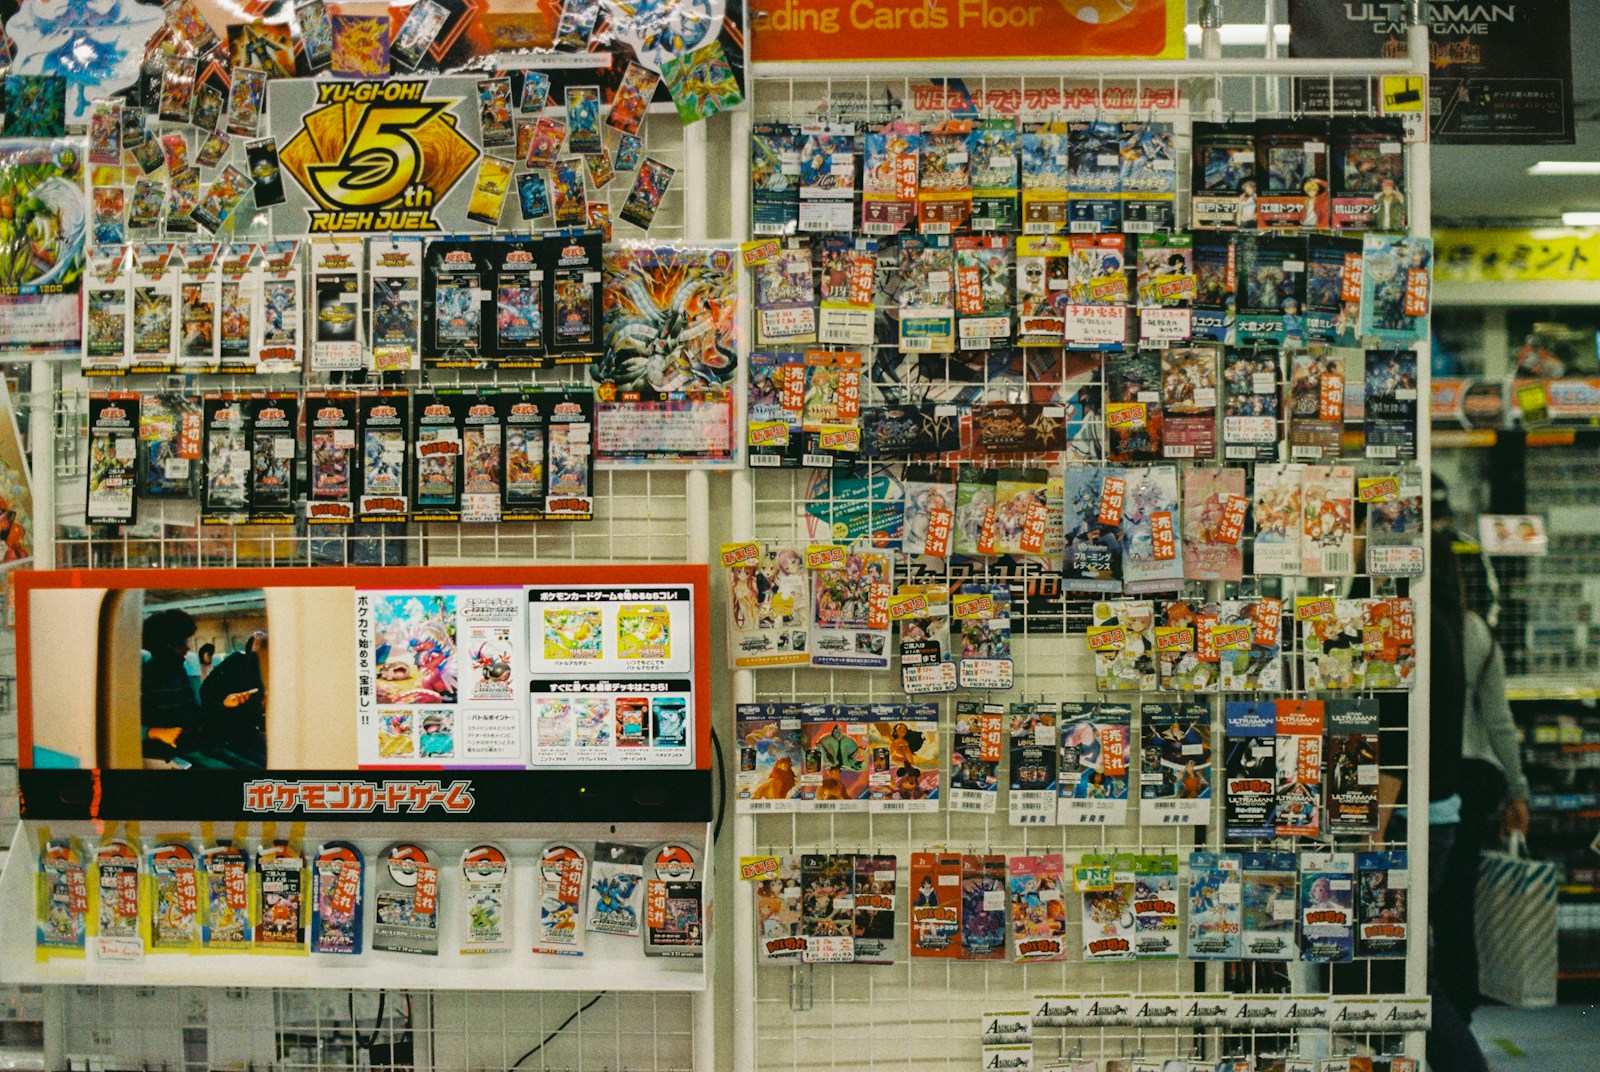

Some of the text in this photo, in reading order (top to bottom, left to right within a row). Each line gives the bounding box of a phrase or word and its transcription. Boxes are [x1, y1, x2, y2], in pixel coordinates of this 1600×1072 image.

[850, 0, 949, 29] Cards
[960, 0, 1042, 29] Floor
[1345, 4, 1515, 23] ULTAMAN
[1433, 22, 1489, 34] GAME
[319, 82, 422, 101] YU-GI-OH!
[307, 98, 455, 209] 5 th
[904, 158, 916, 198] 売切れ
[309, 211, 437, 231] RUSH DUEL
[744, 243, 778, 263] 新製品
[39, 285, 63, 293] 1200
[858, 261, 873, 301] 売切れ
[966, 271, 981, 310] 売切れ
[1093, 282, 1126, 298] 新製品
[1160, 279, 1194, 297] 新製品
[790, 366, 803, 406] 売切れ
[845, 371, 858, 413] 売切れ
[1328, 376, 1342, 416] 売切れ
[1109, 407, 1143, 425] 新製品
[752, 426, 787, 442] 新製品
[823, 431, 858, 446] 新製品
[420, 441, 459, 456] BOX切れ
[1361, 481, 1396, 500] 新製品
[310, 503, 350, 517] BOX切れ
[364, 498, 404, 512] BOX切れ
[550, 498, 589, 512] BOX切れ
[1106, 481, 1124, 521] 売切れ
[1028, 506, 1046, 547] 売切れ
[1226, 499, 1247, 539] 売切れ
[933, 512, 950, 553] 売切れ
[1158, 517, 1173, 555] 売切れ
[723, 545, 758, 565] 新製品
[808, 549, 843, 566] 新製品
[1074, 552, 1112, 561] ブルーミング
[1073, 562, 1110, 570] レディアンス
[876, 584, 889, 624] 売切れ
[890, 597, 926, 617] 新製品
[955, 598, 991, 617] 新製品
[1299, 600, 1334, 617] 新製品
[1263, 601, 1280, 641] 売切れ
[1089, 630, 1124, 647] 新製品
[1156, 631, 1192, 648] 新製品
[1214, 629, 1249, 647] 新製品
[987, 718, 1001, 757] 売切れ
[1110, 730, 1123, 769] 売切れ
[1305, 740, 1317, 779] 売切れ
[245, 782, 474, 811] ポケモンカードゲーム
[1020, 815, 1046, 823] 新発売
[1163, 815, 1189, 823] 新発売
[567, 857, 583, 898] 売切れ
[742, 859, 778, 877] 新製品
[1075, 868, 1111, 880] 値下げ
[182, 871, 196, 909] 売切れ
[233, 867, 245, 904] 売切れ
[339, 868, 360, 908] 売切れ
[422, 869, 436, 909] 売切れ
[654, 884, 664, 923] 売切れ
[1134, 900, 1176, 914] BOX切れ
[914, 908, 956, 922] BOX切れ
[766, 938, 807, 953] BOX切れ
[1019, 940, 1060, 953] BOX切れ
[1089, 938, 1130, 953] BOX切れ
